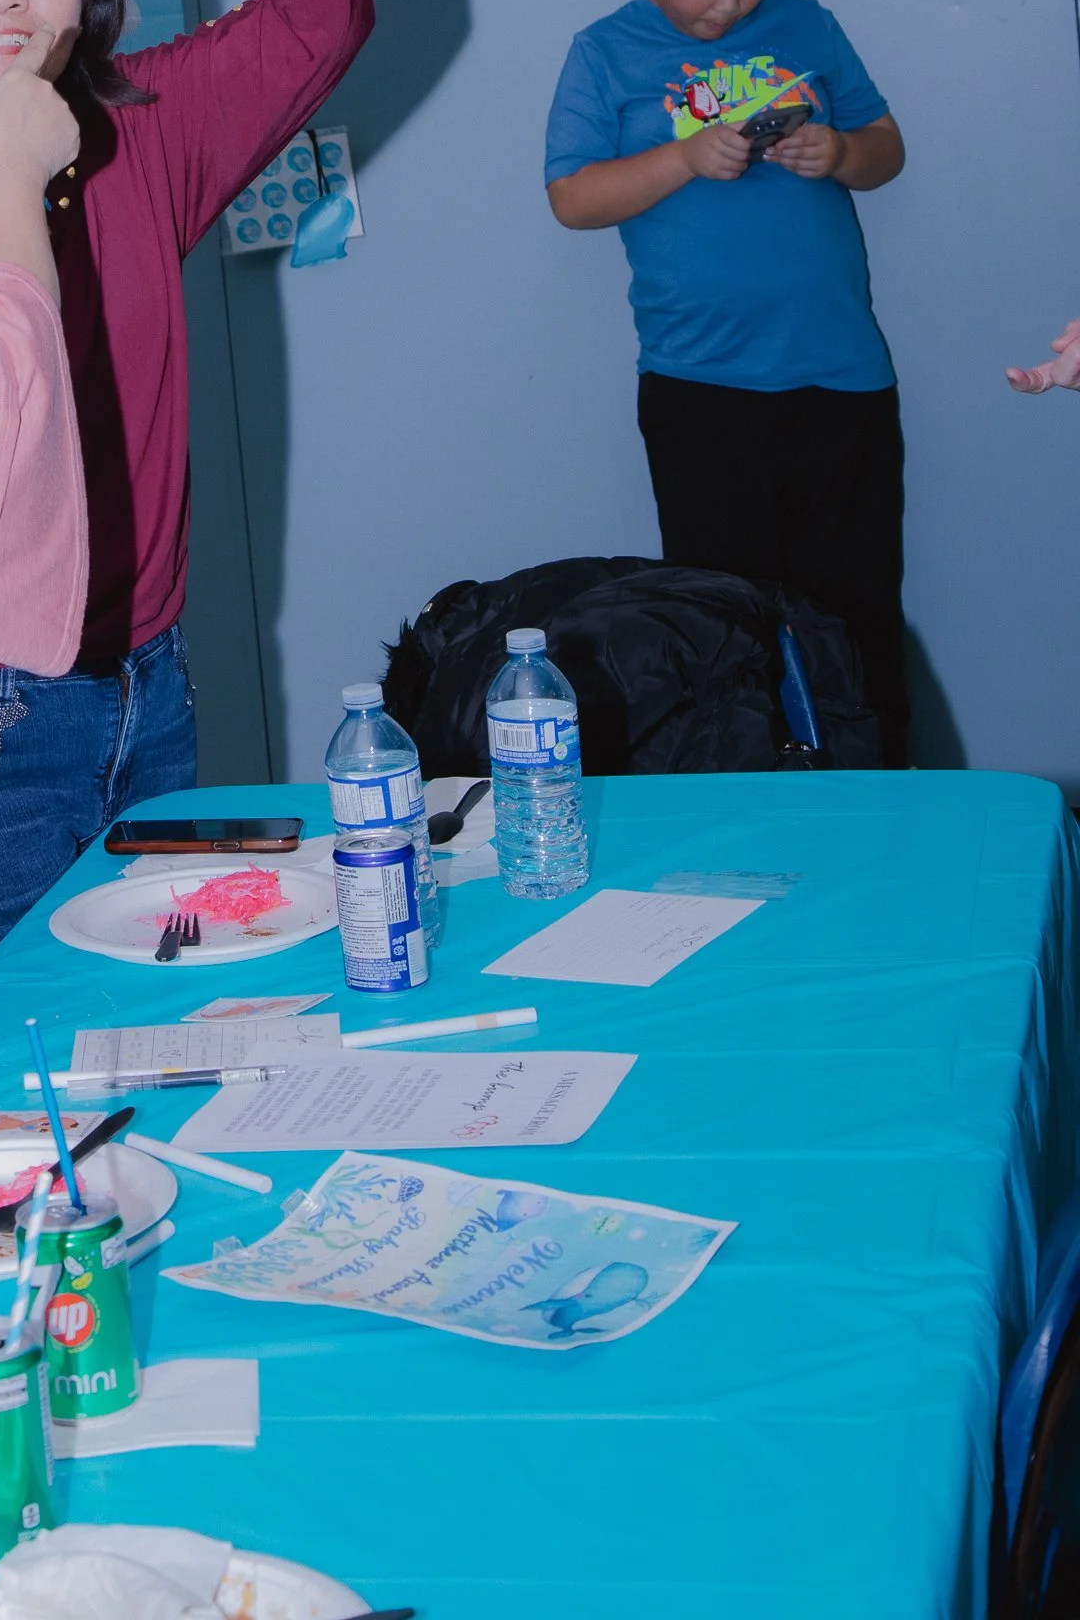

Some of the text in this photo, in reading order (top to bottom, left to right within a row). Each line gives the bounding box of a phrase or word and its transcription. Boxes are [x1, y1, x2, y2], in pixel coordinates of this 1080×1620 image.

[463, 1061, 524, 1112] The bump
[537, 1077, 577, 1115] MESSAGE
[518, 1116, 549, 1136] FROM
[363, 1206, 427, 1256] Baby
[442, 1241, 564, 1315] Welcome
[55, 1368, 117, 1395] mini
